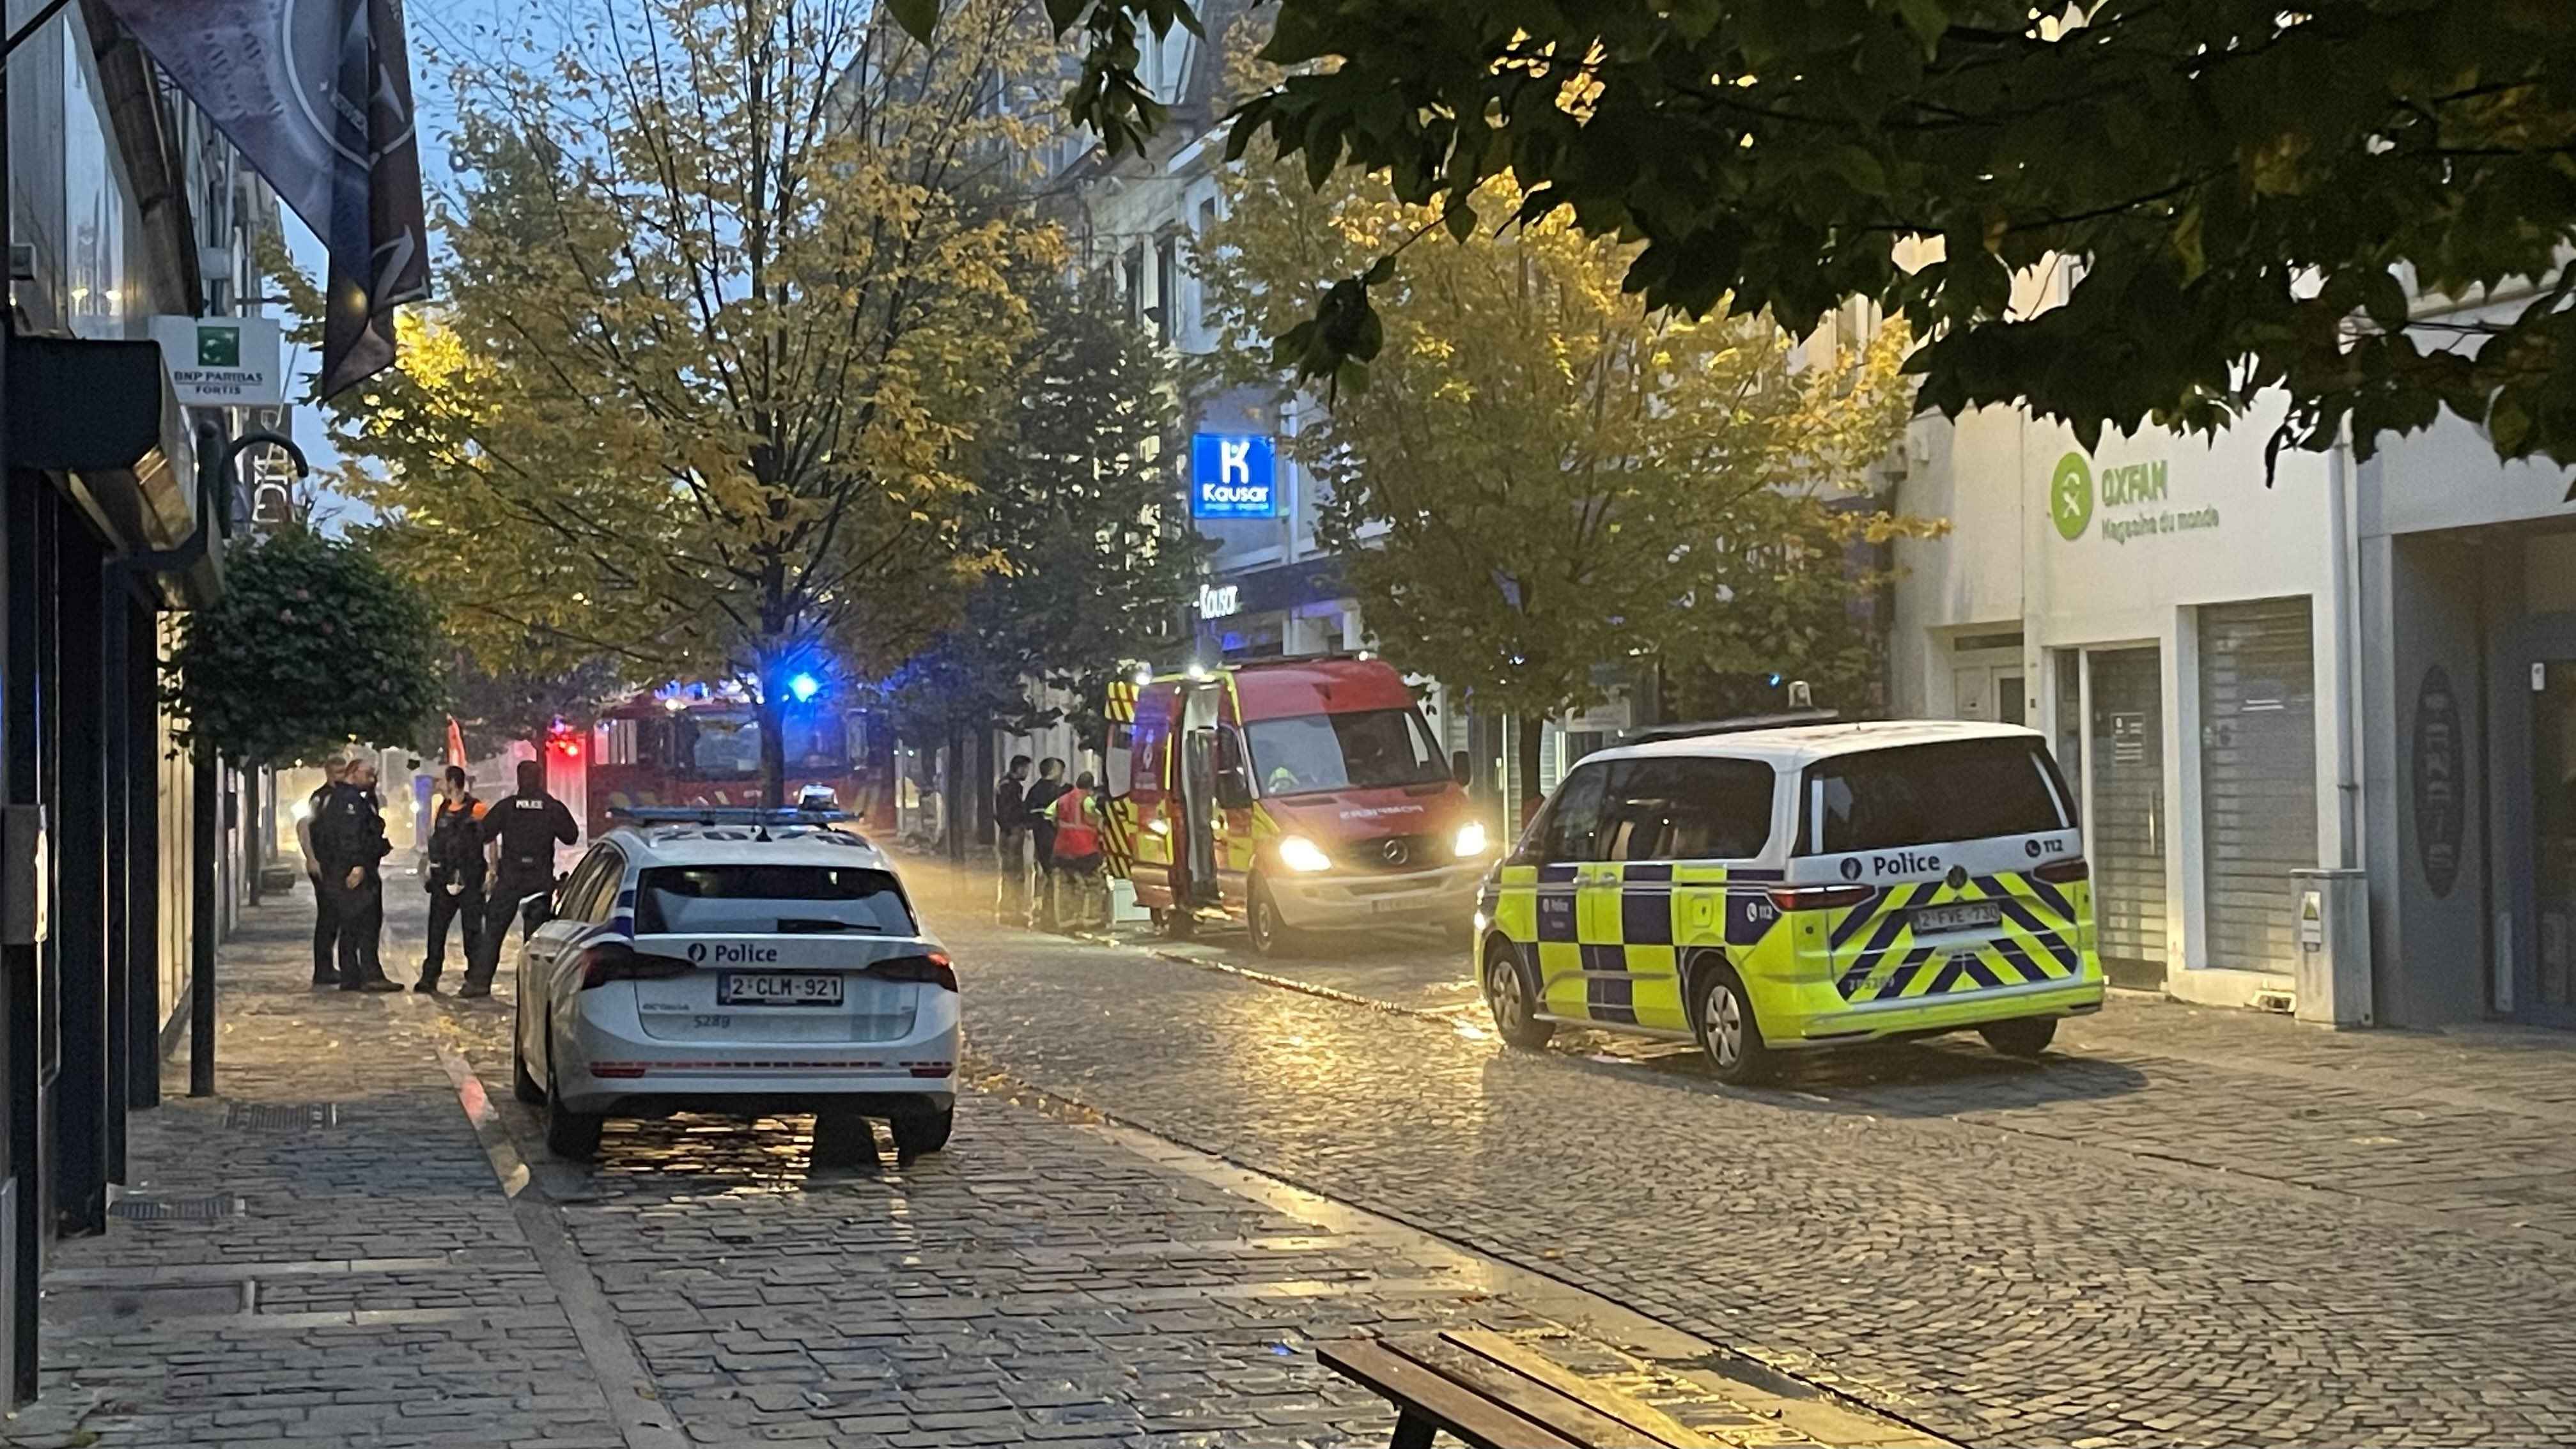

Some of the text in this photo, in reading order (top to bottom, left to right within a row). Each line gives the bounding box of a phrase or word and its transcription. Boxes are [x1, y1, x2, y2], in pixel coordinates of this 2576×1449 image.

[174, 371, 263, 382] BNP PARIBAS
[196, 385, 241, 394] FORTIS
[1203, 483, 1268, 502] Kausar
[2102, 460, 2168, 507] OXFAM
[2159, 510, 2175, 533] du
[2177, 504, 2219, 531] monde
[1200, 584, 1238, 619] Kausar
[516, 800, 543, 809] POLICE
[2043, 839, 2063, 853] 112
[1874, 853, 1940, 877] Police
[715, 944, 777, 962] Police
[694, 1014, 731, 1028] 5289
